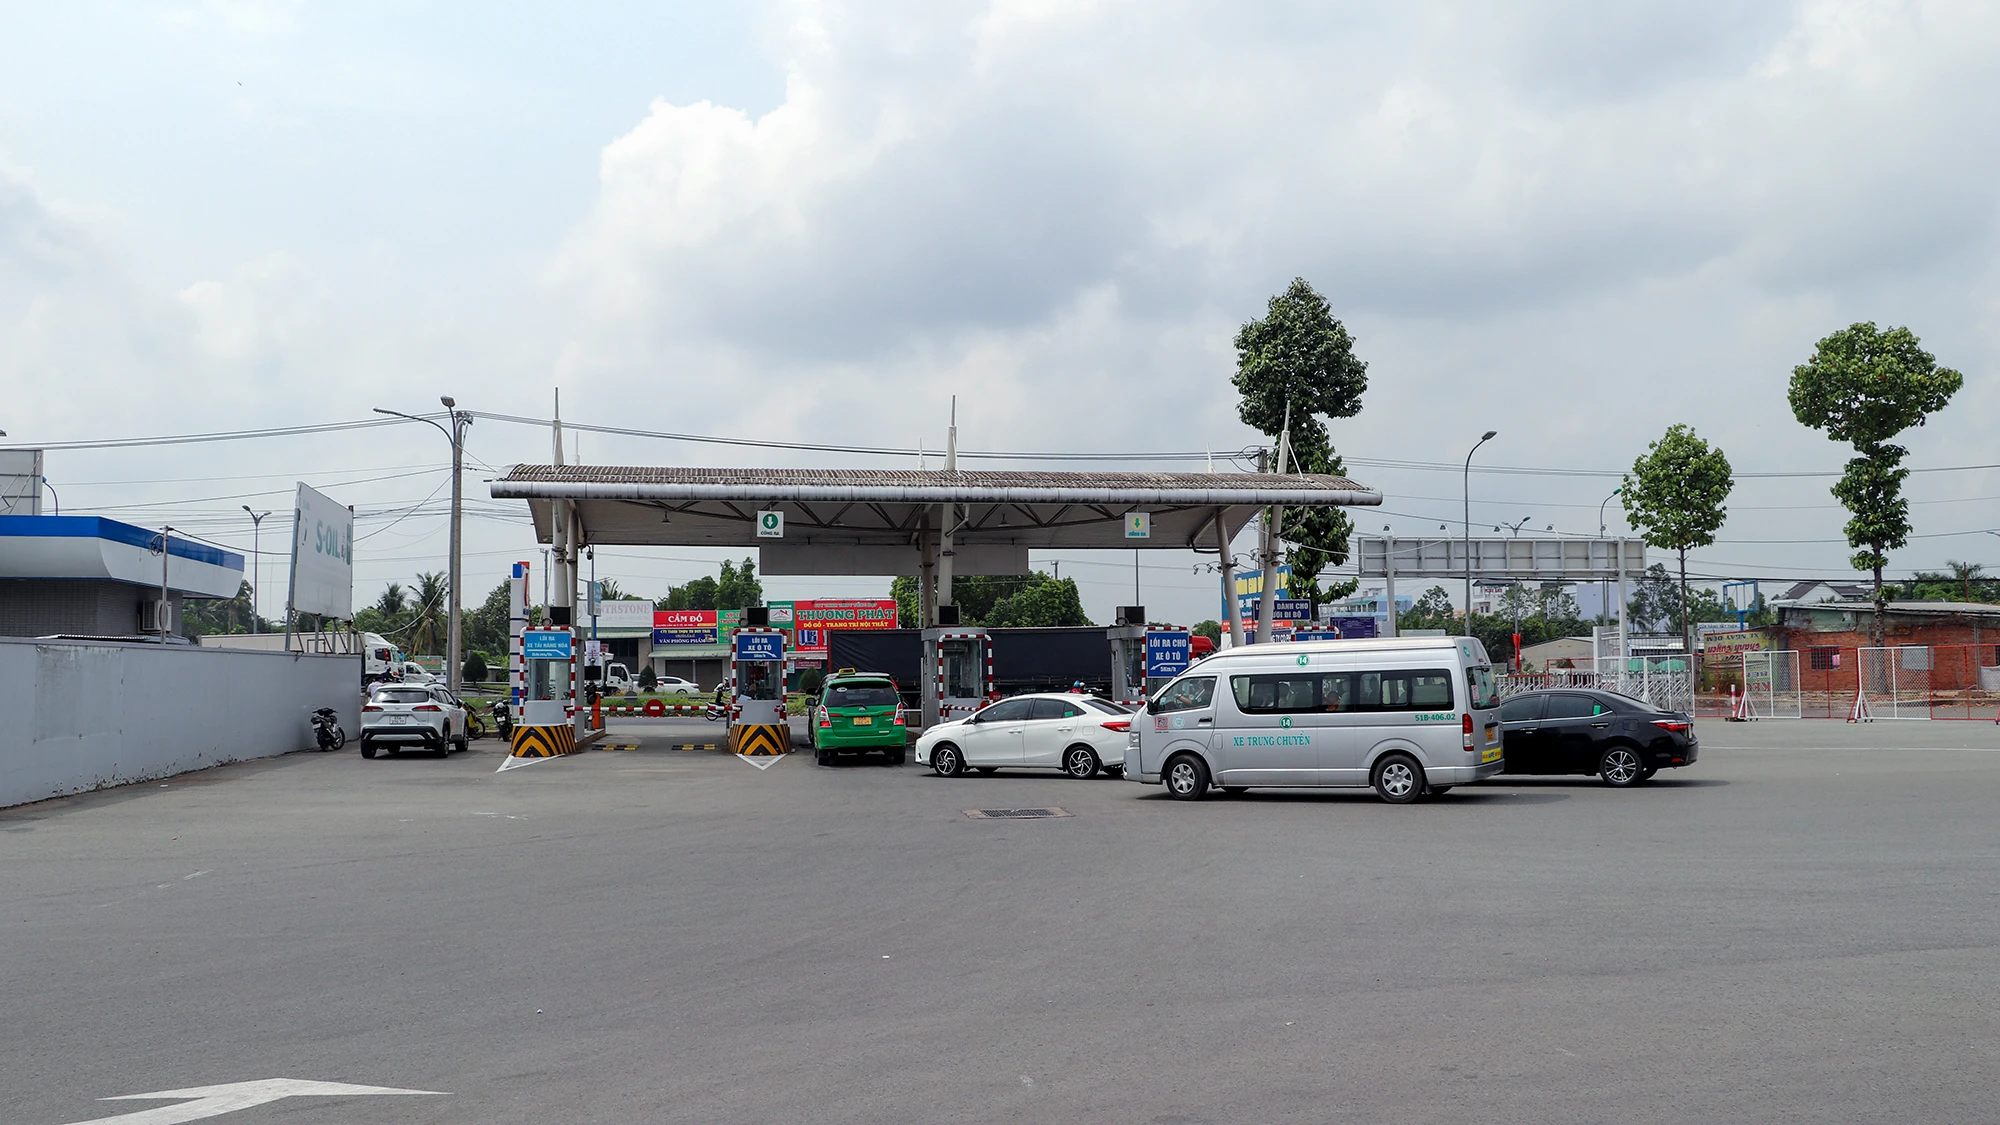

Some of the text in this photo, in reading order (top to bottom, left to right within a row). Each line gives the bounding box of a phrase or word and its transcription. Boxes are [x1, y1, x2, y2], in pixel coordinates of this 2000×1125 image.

[1149, 636, 1187, 648] LỐI RA CHO
[756, 643, 762, 651] Ô
[1155, 650, 1181, 661] XE Ô TÔ
[1298, 656, 1307, 665] 14
[1414, 713, 1456, 722] 51B-406.02
[1282, 719, 1291, 727] 14
[1233, 736, 1245, 747] XE
[1246, 736, 1275, 746] TRUNG
